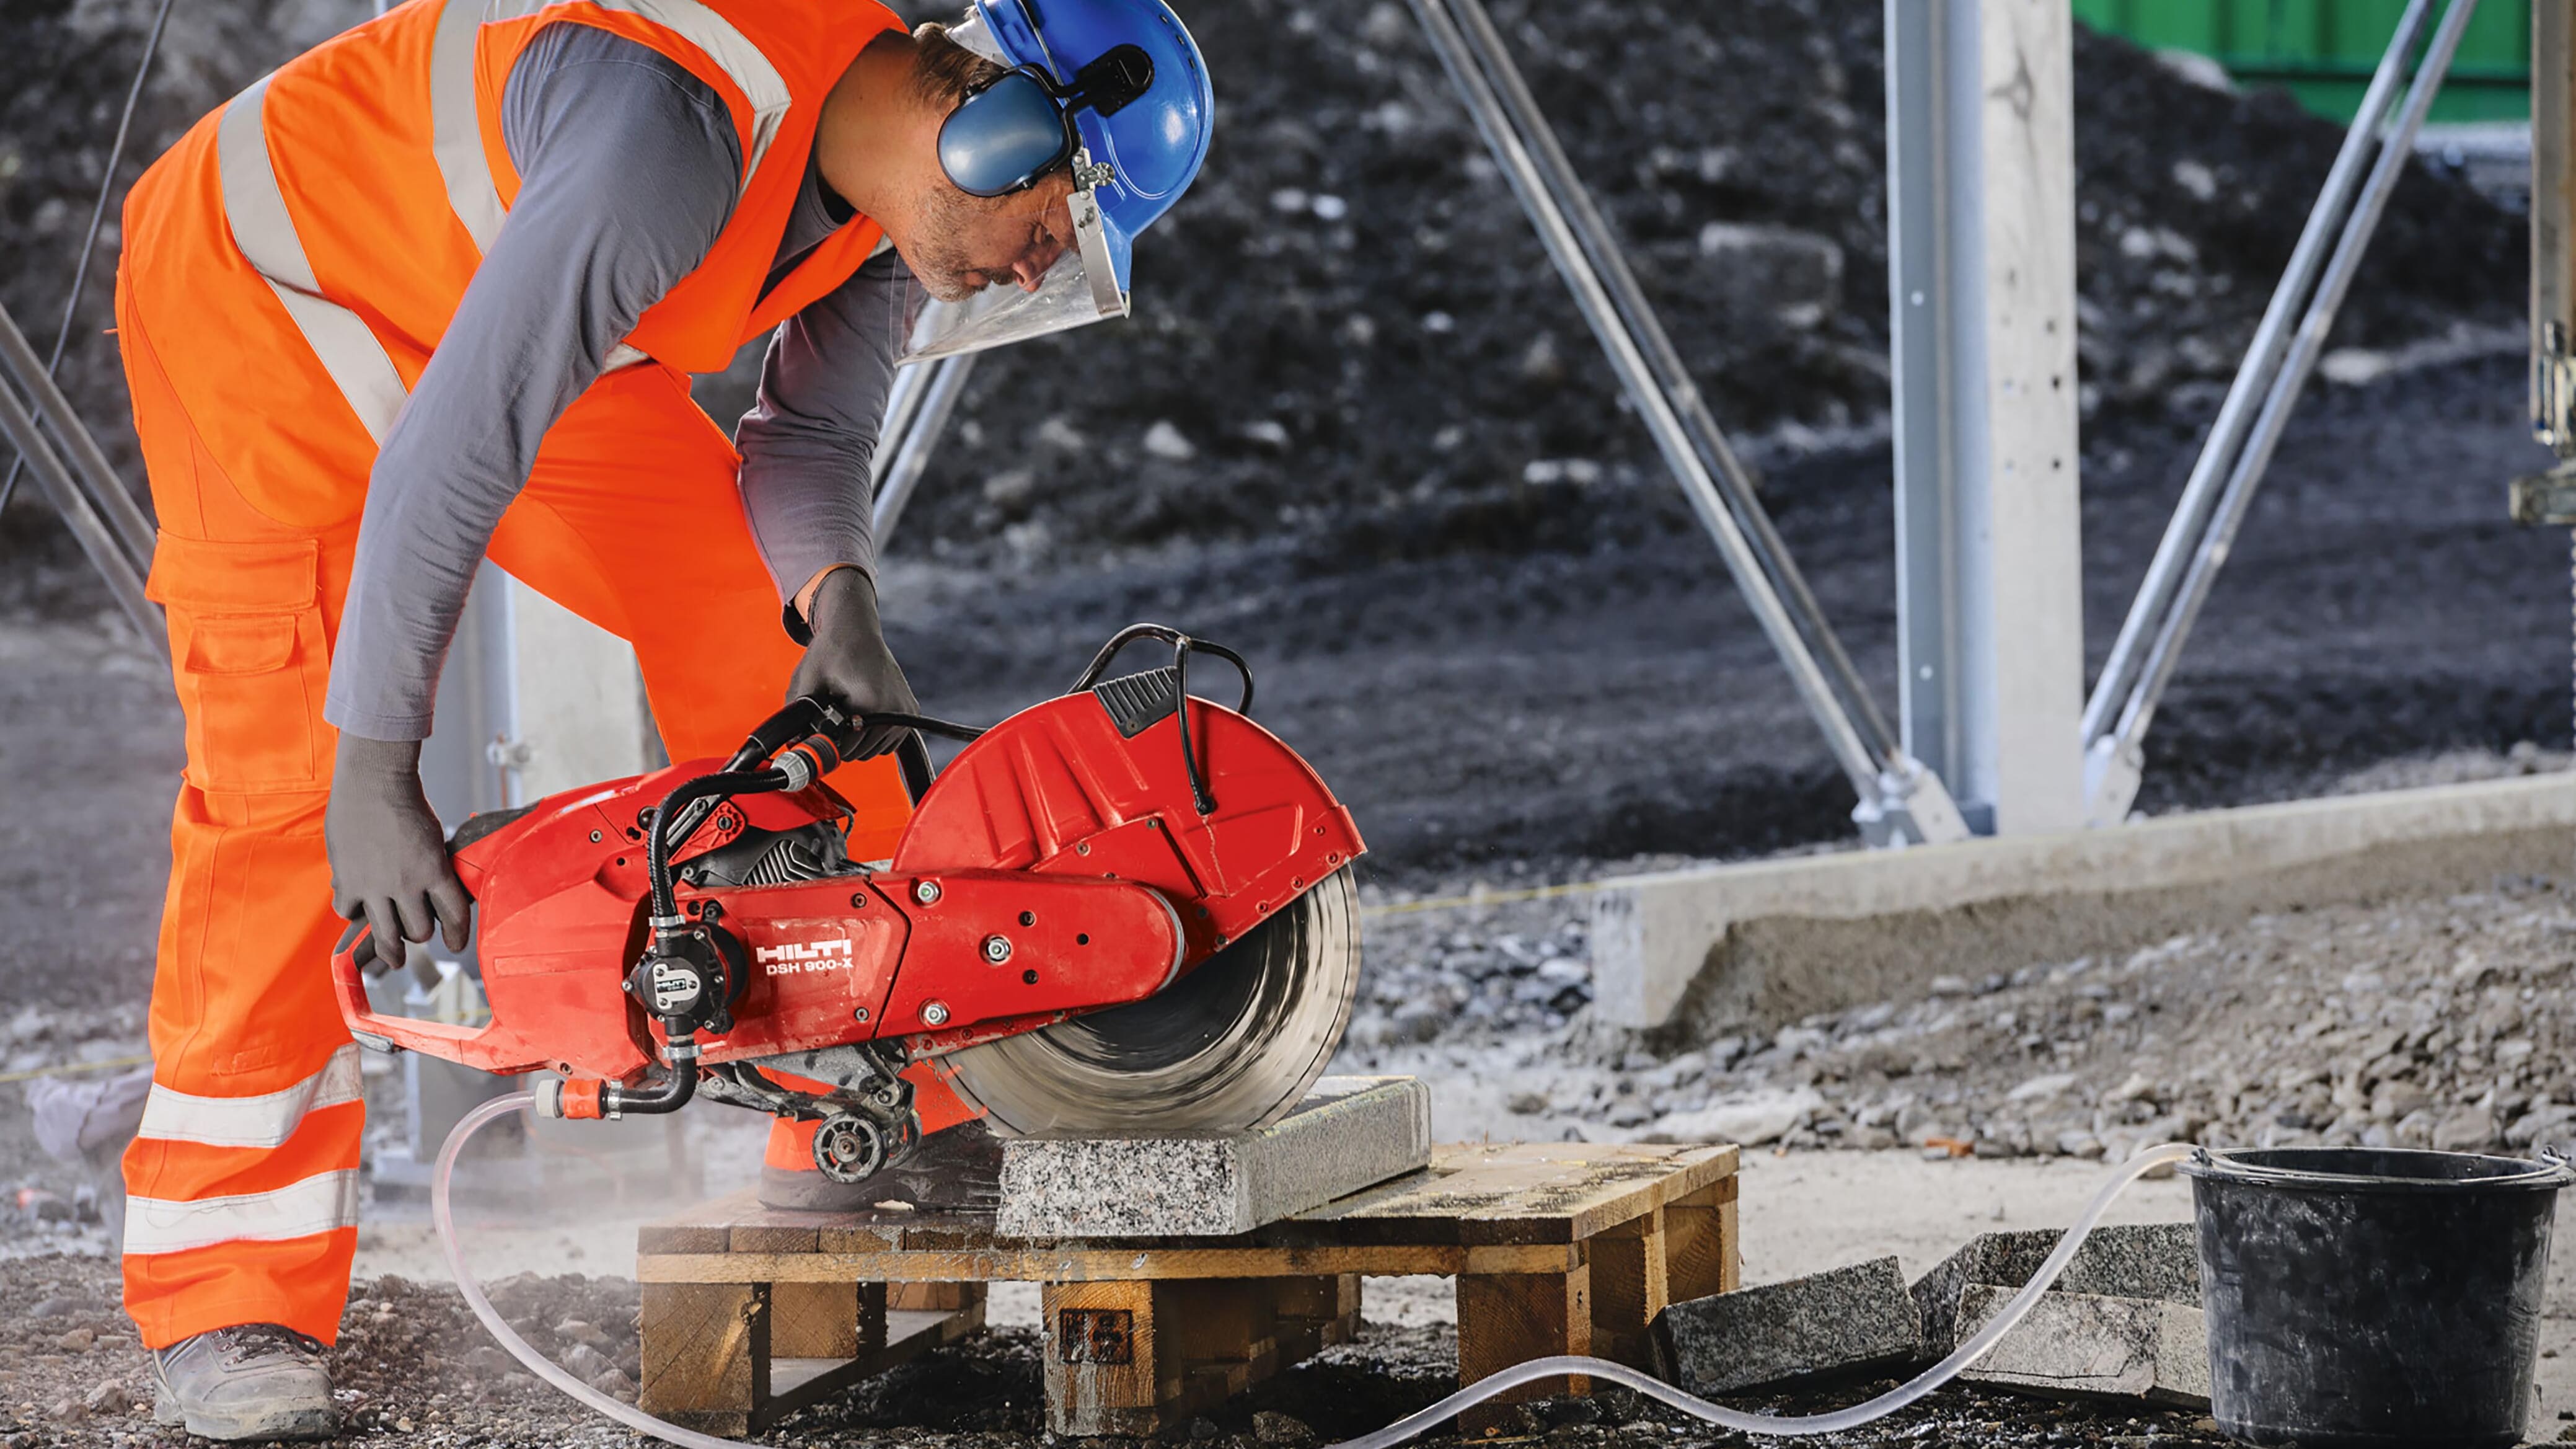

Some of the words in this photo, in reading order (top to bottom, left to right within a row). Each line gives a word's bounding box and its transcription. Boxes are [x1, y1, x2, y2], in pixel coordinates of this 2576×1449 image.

[756, 939, 852, 963] HILTI
[765, 963, 800, 975] DSH
[805, 957, 854, 972] 900-X
